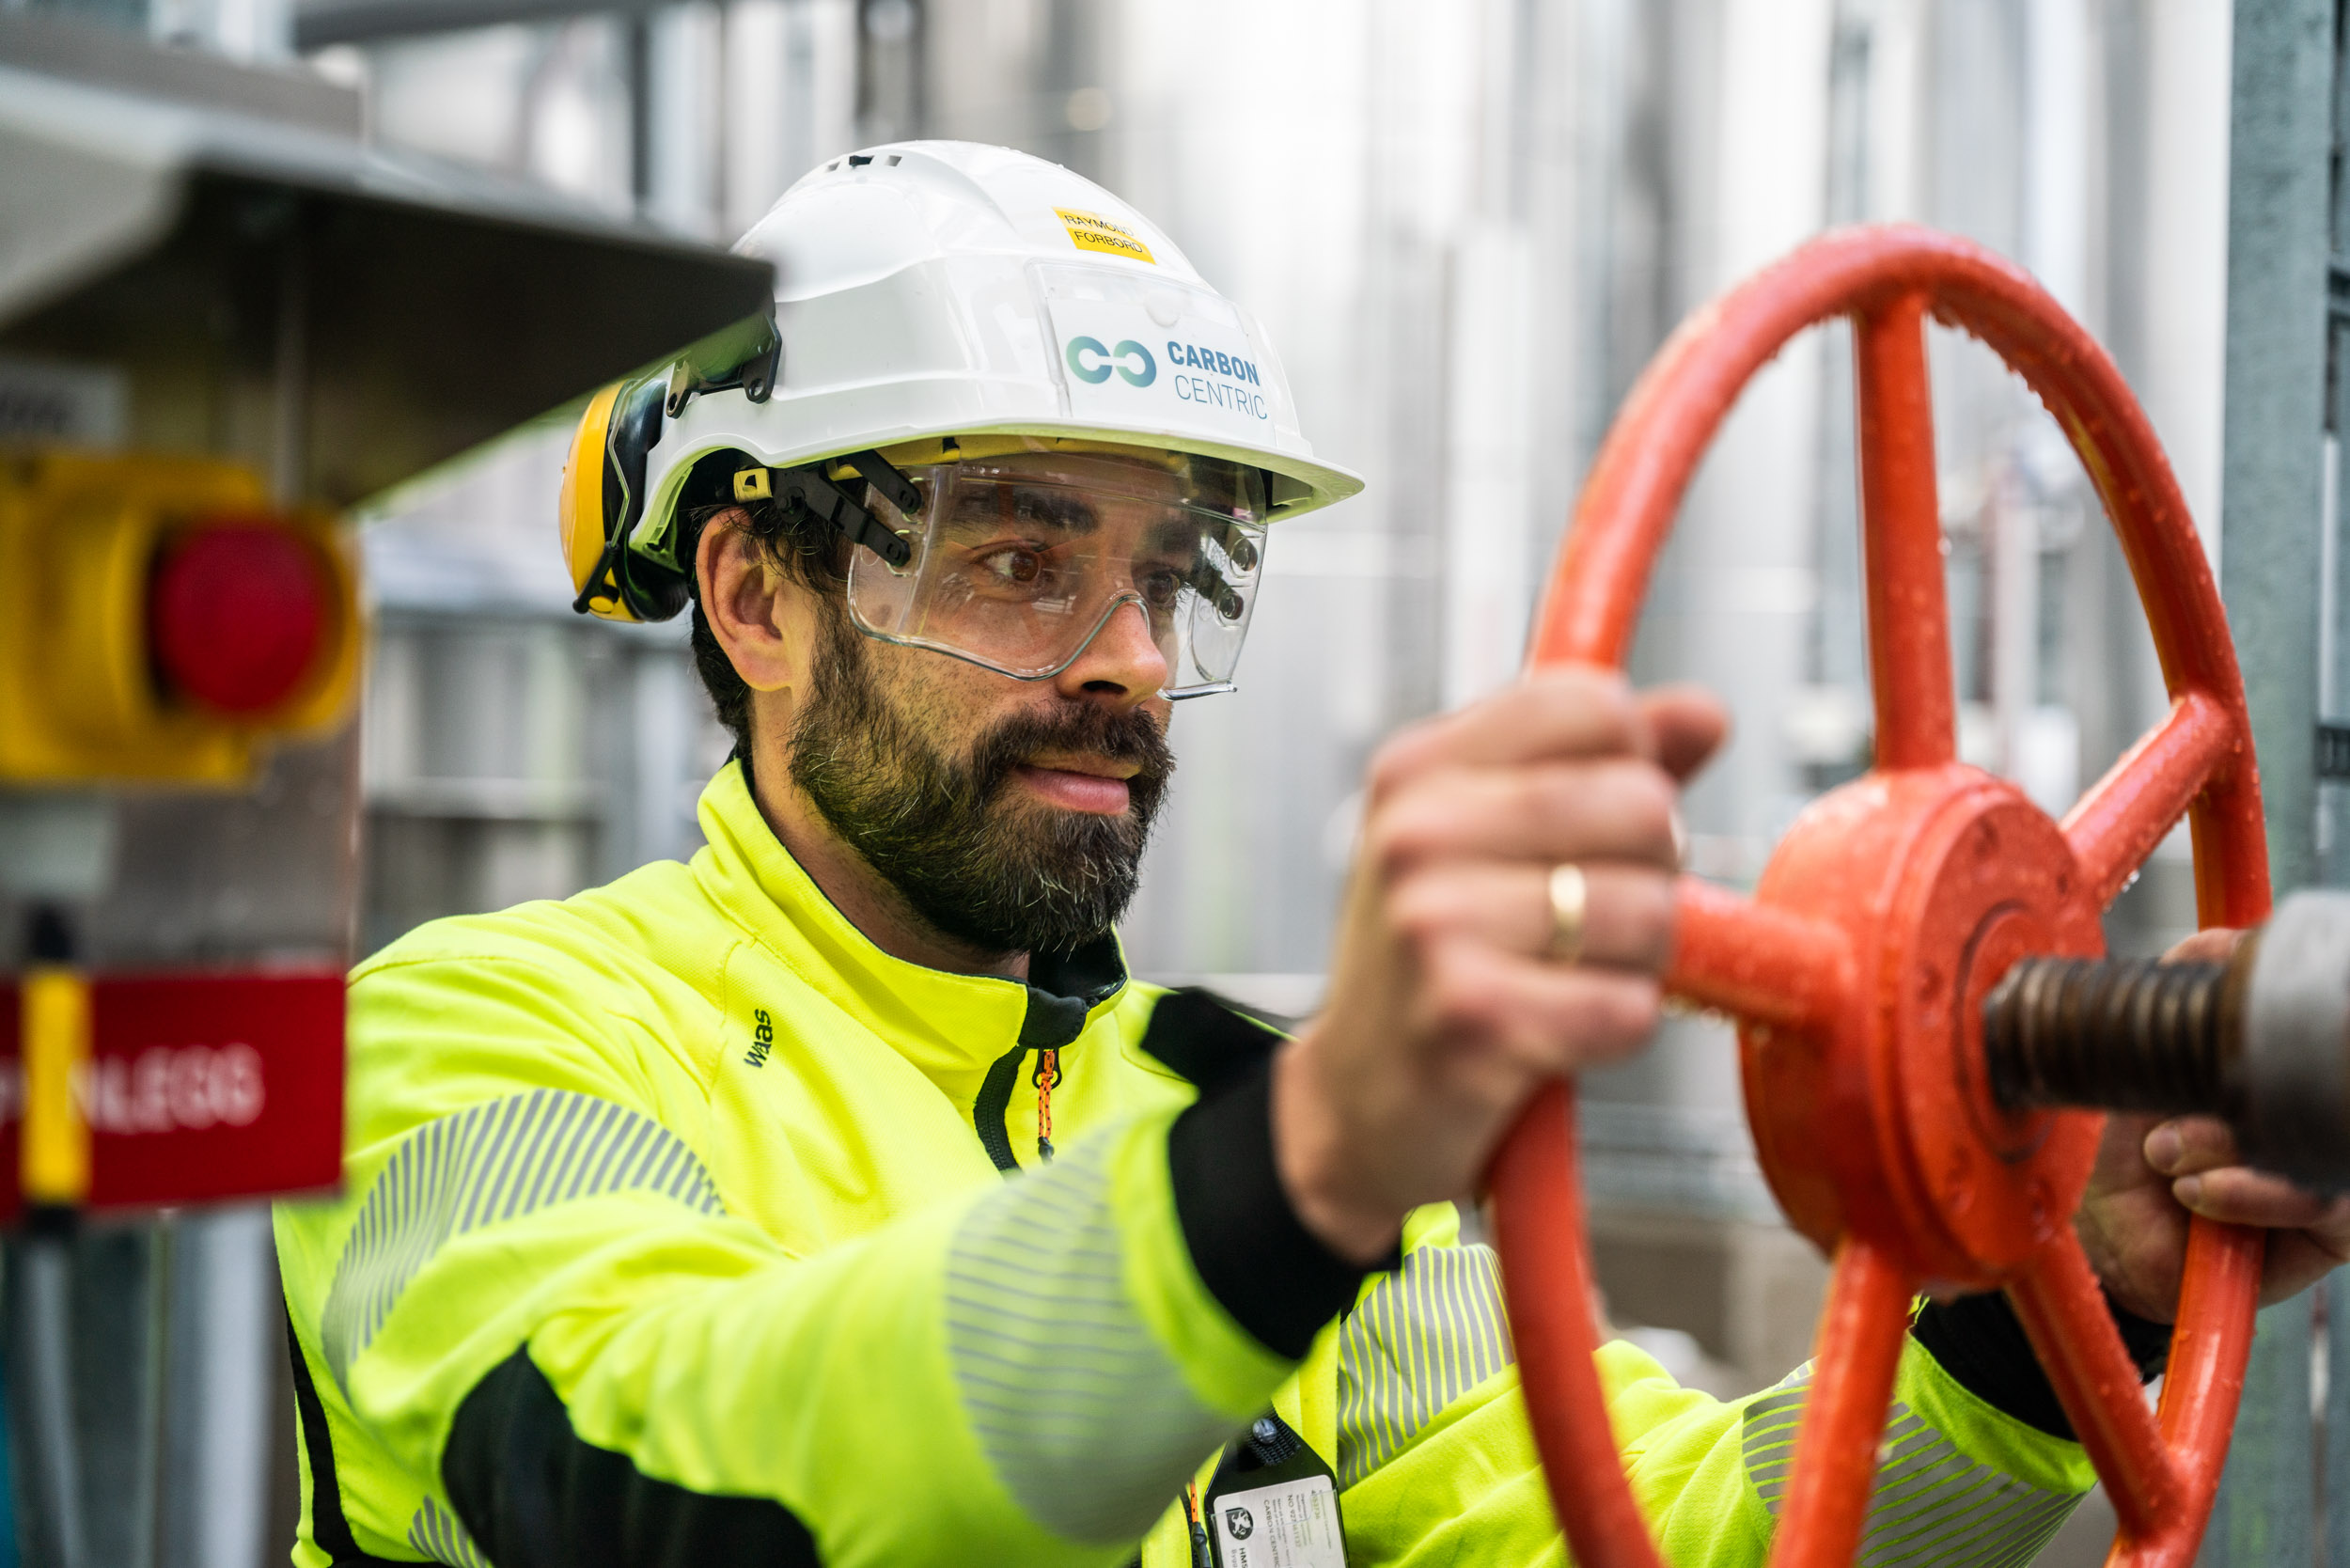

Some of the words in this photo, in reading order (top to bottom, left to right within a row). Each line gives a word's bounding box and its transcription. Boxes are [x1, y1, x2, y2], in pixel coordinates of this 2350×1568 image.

[1064, 214, 1135, 237] RAYMOND
[1073, 230, 1143, 254] FORBORD
[1167, 341, 1261, 387] CARBON
[1175, 374, 1268, 420] CENTRIC
[1263, 1499, 1274, 1534] CARBON
